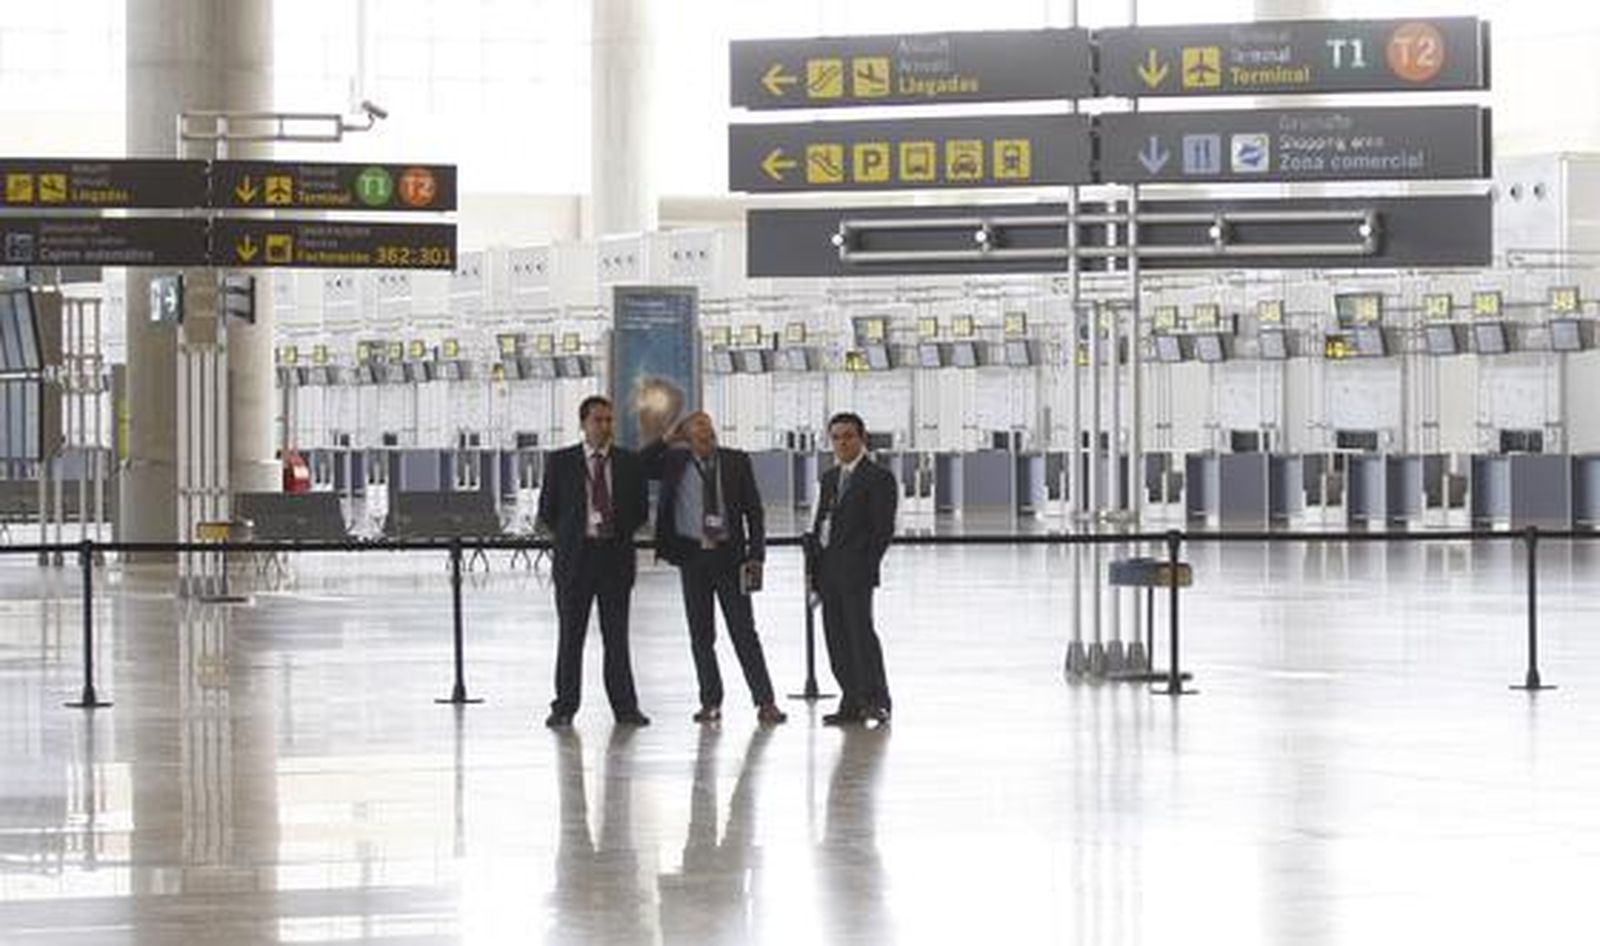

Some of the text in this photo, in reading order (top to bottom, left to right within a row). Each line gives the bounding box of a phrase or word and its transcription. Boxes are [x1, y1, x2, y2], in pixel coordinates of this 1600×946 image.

[1326, 37, 1367, 69] T1
[1393, 34, 1437, 68] T2
[899, 74, 979, 95] Llegadas
[1231, 65, 1311, 86] Terminal
[863, 150, 883, 174] P
[1279, 148, 1424, 170] Zona comercial
[362, 174, 434, 199] T1 T2
